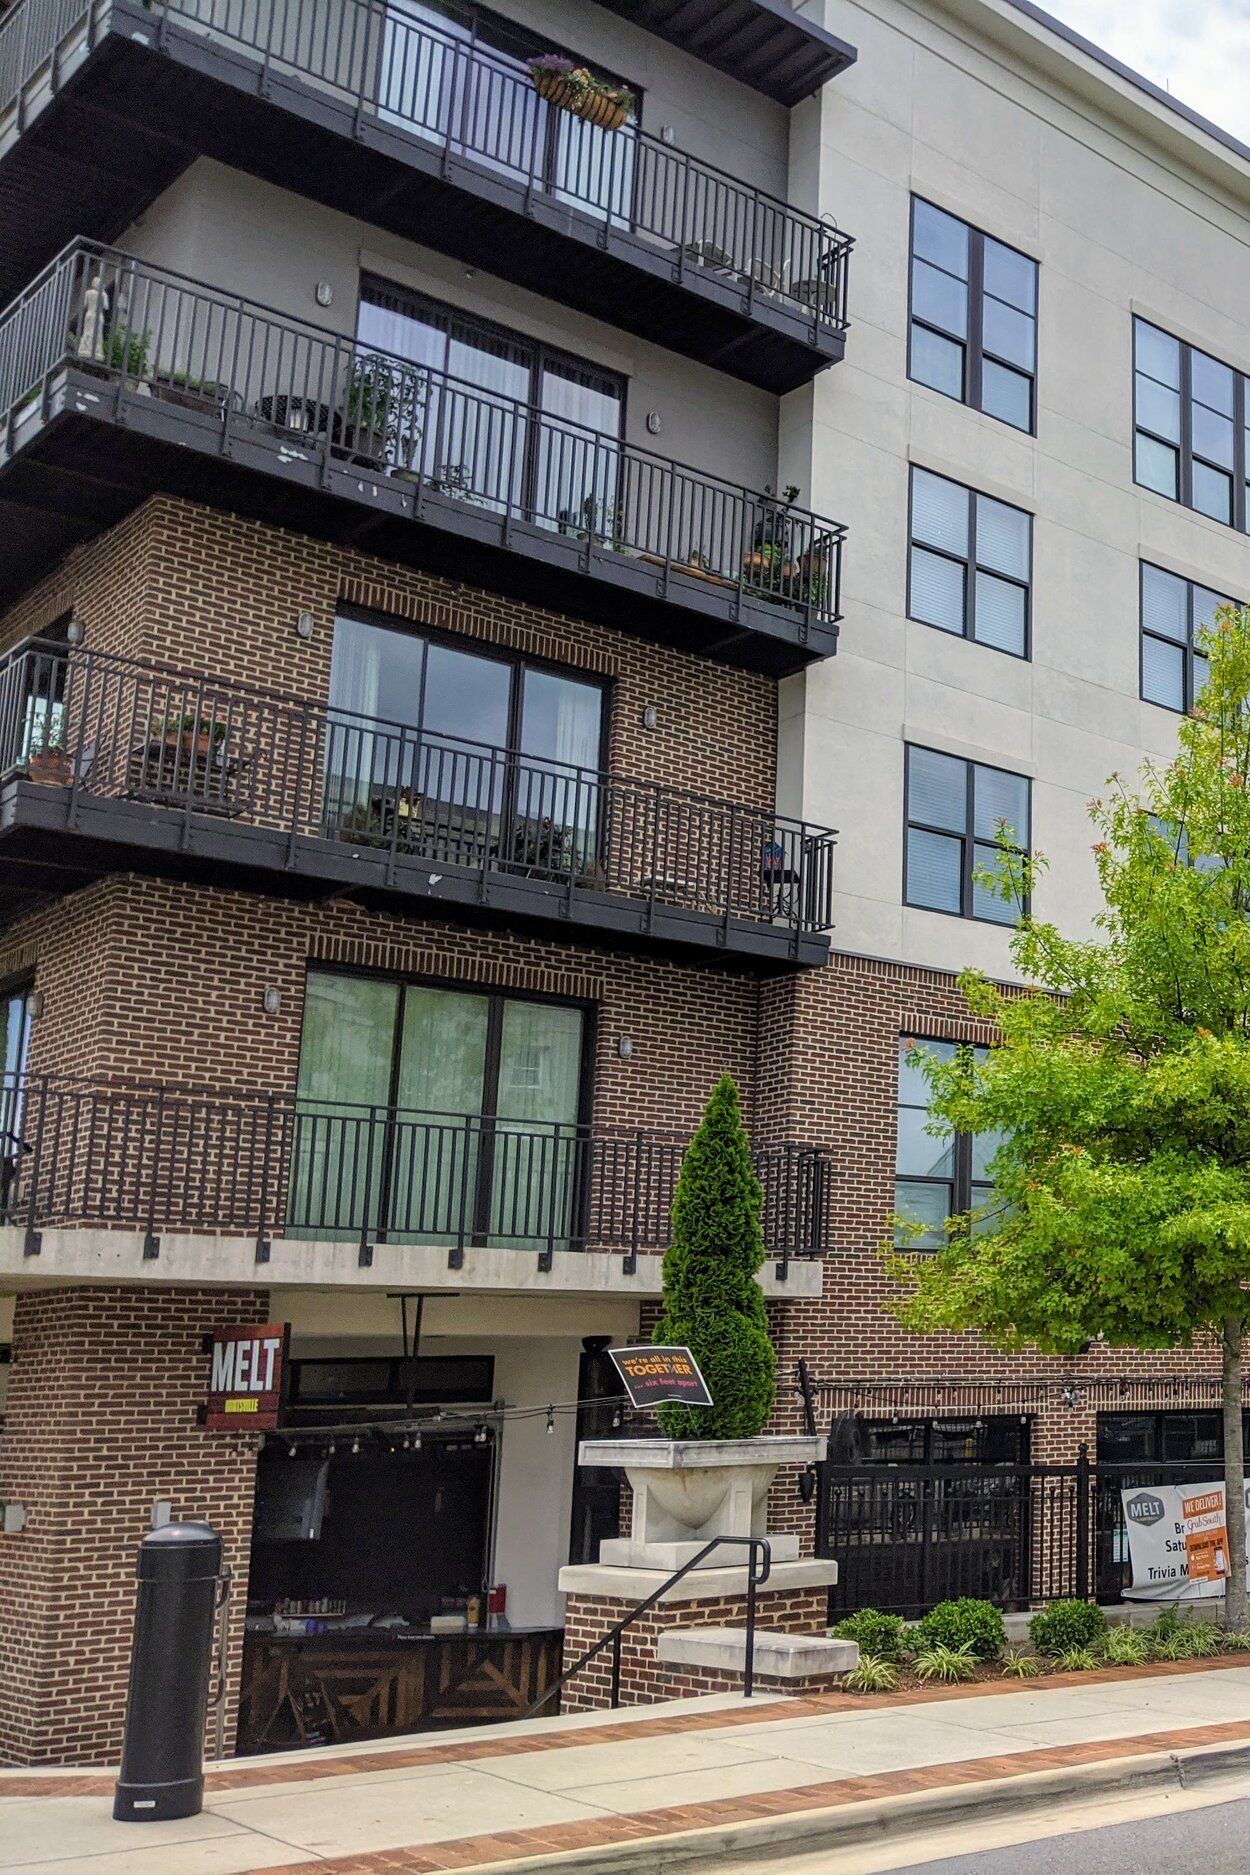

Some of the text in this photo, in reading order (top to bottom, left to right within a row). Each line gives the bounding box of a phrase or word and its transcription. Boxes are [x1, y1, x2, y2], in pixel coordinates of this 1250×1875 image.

[211, 1339, 280, 1391] MELT
[622, 1355, 688, 1365] we're all in this
[645, 1379, 659, 1387] six
[677, 1380, 699, 1388] apart
[1130, 1501, 1161, 1518] MELT
[1184, 1499, 1195, 1513] WE
[1148, 1565, 1176, 1580] Trivia
